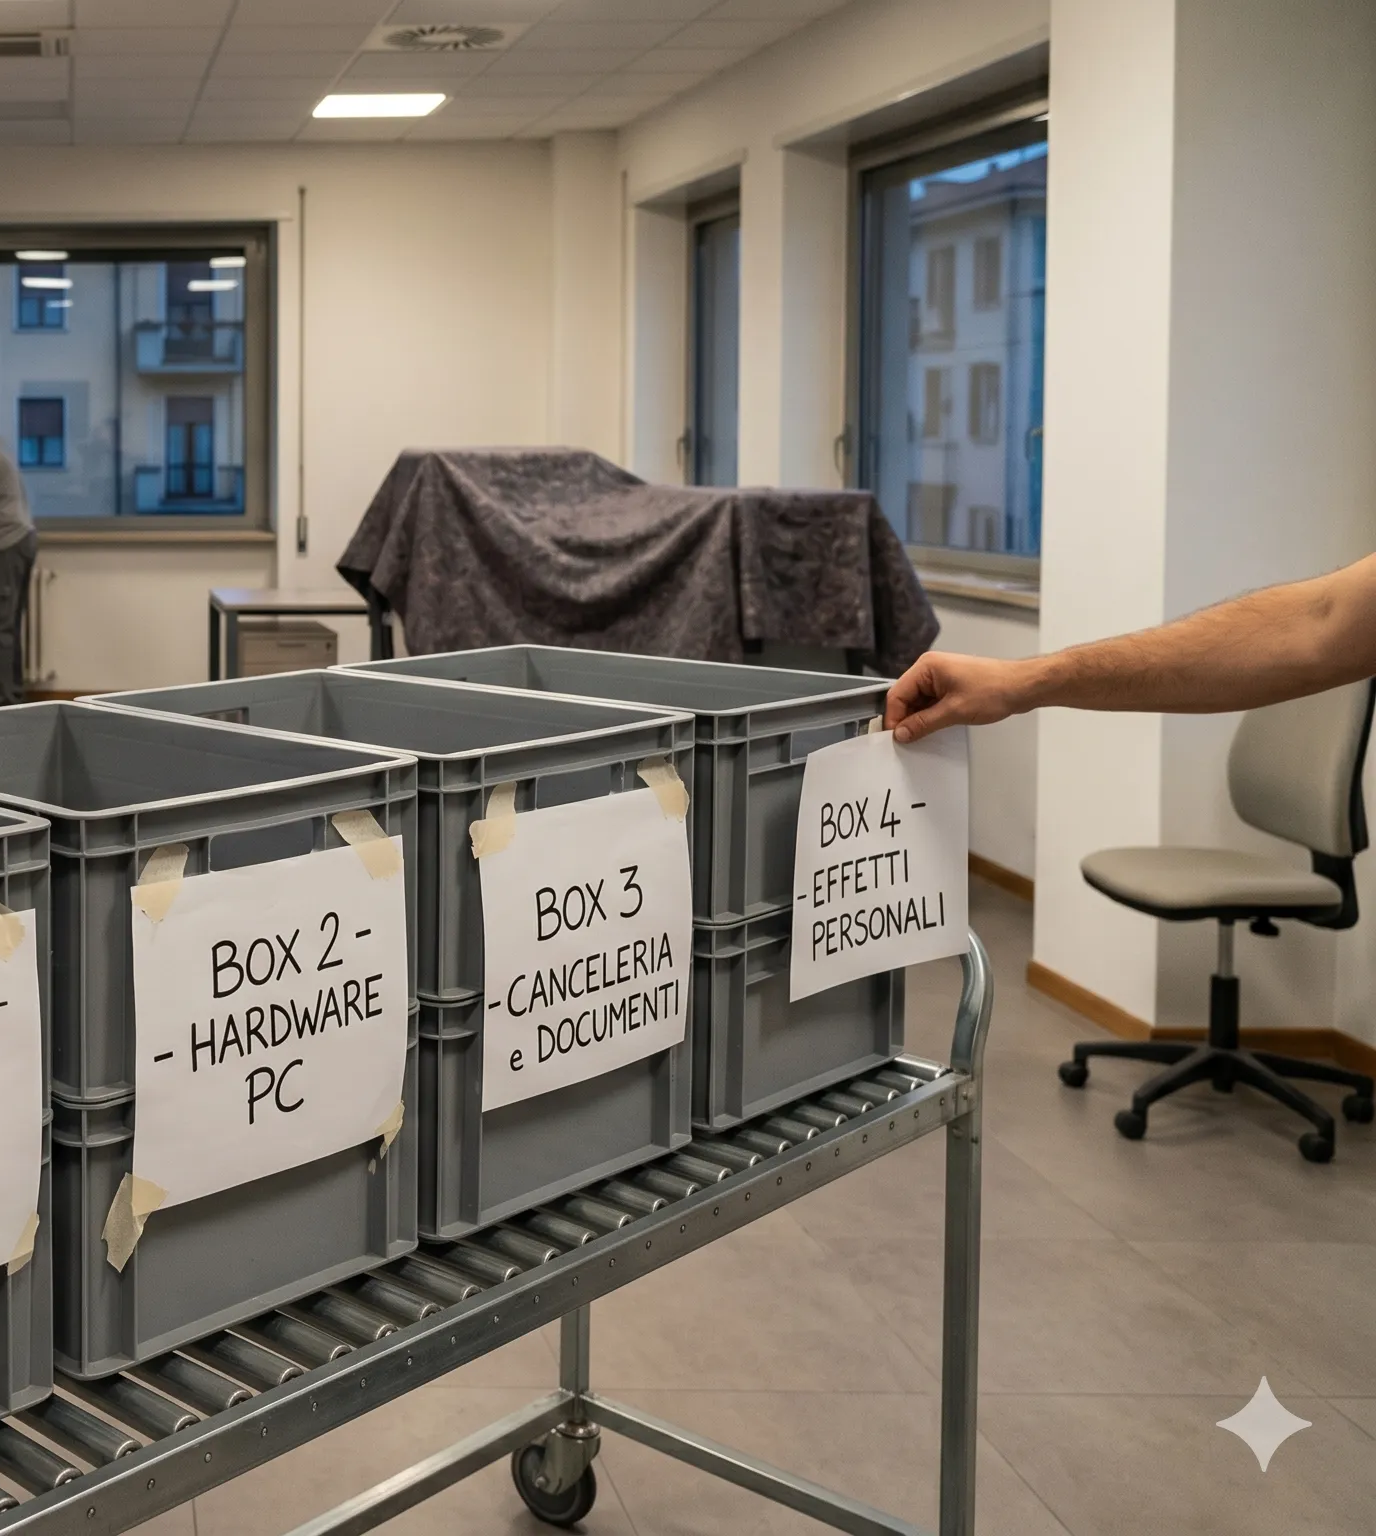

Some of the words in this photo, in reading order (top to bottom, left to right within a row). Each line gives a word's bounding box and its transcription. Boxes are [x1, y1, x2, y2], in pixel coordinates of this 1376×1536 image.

[820, 796, 869, 849] BOX
[535, 879, 607, 942] BOX
[619, 864, 643, 919] 3
[812, 891, 945, 962] PERSONALI
[212, 929, 302, 999] BOX
[191, 973, 383, 1073] HARDWARE
[509, 1049, 524, 1072] e
[537, 979, 679, 1064] DOCUMENTI
[245, 1059, 305, 1125] PC
